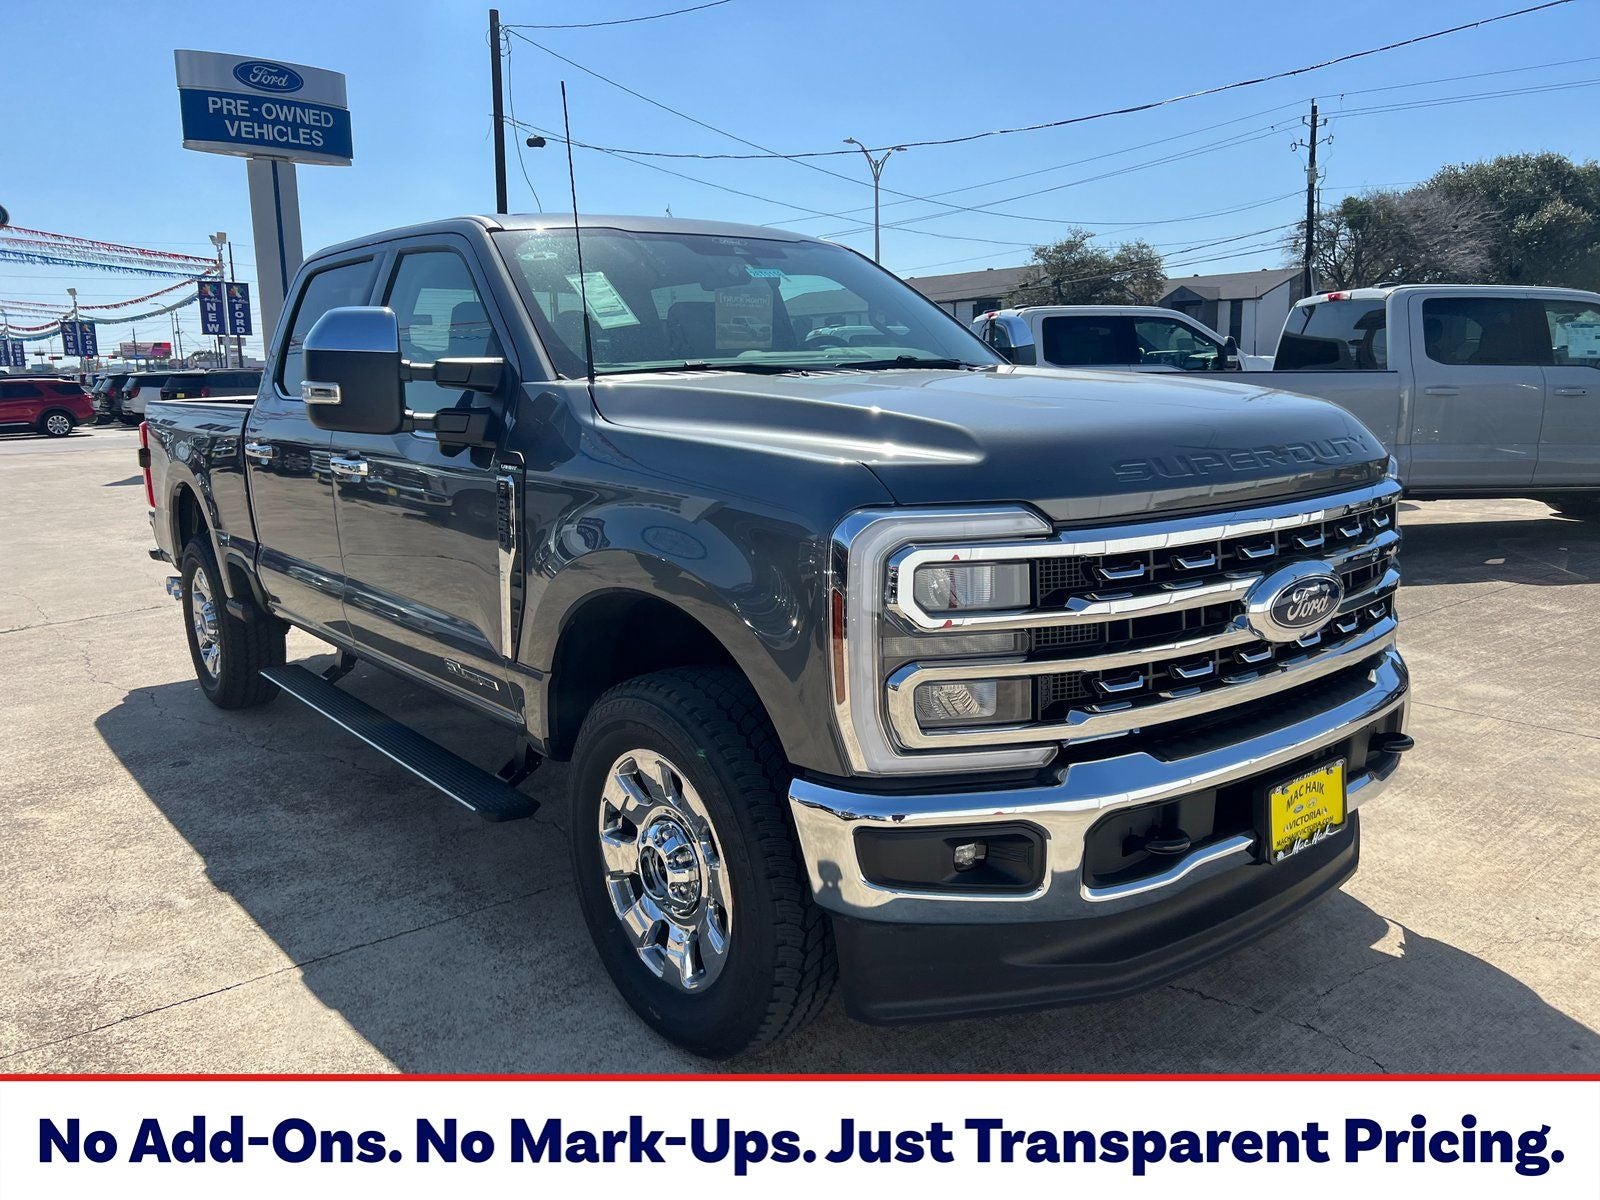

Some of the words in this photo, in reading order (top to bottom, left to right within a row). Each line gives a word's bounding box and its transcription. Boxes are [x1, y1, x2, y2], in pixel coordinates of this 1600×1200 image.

[249, 65, 289, 87] Ford
[225, 119, 324, 147] VEHICLES
[206, 303, 219, 332] NEW
[235, 303, 245, 333] FORD
[66, 335, 76, 354] NEW
[86, 335, 94, 355] FORD
[1110, 448, 1287, 483] SUPER
[1286, 434, 1370, 463] DUTY
[1286, 583, 1330, 621] Ford
[1286, 784, 1304, 812] MAC
[1305, 780, 1325, 796] HAIK
[1288, 808, 1321, 830] VICTORIA
[1292, 839, 1312, 855] Mac
[1311, 824, 1331, 845] Haik
